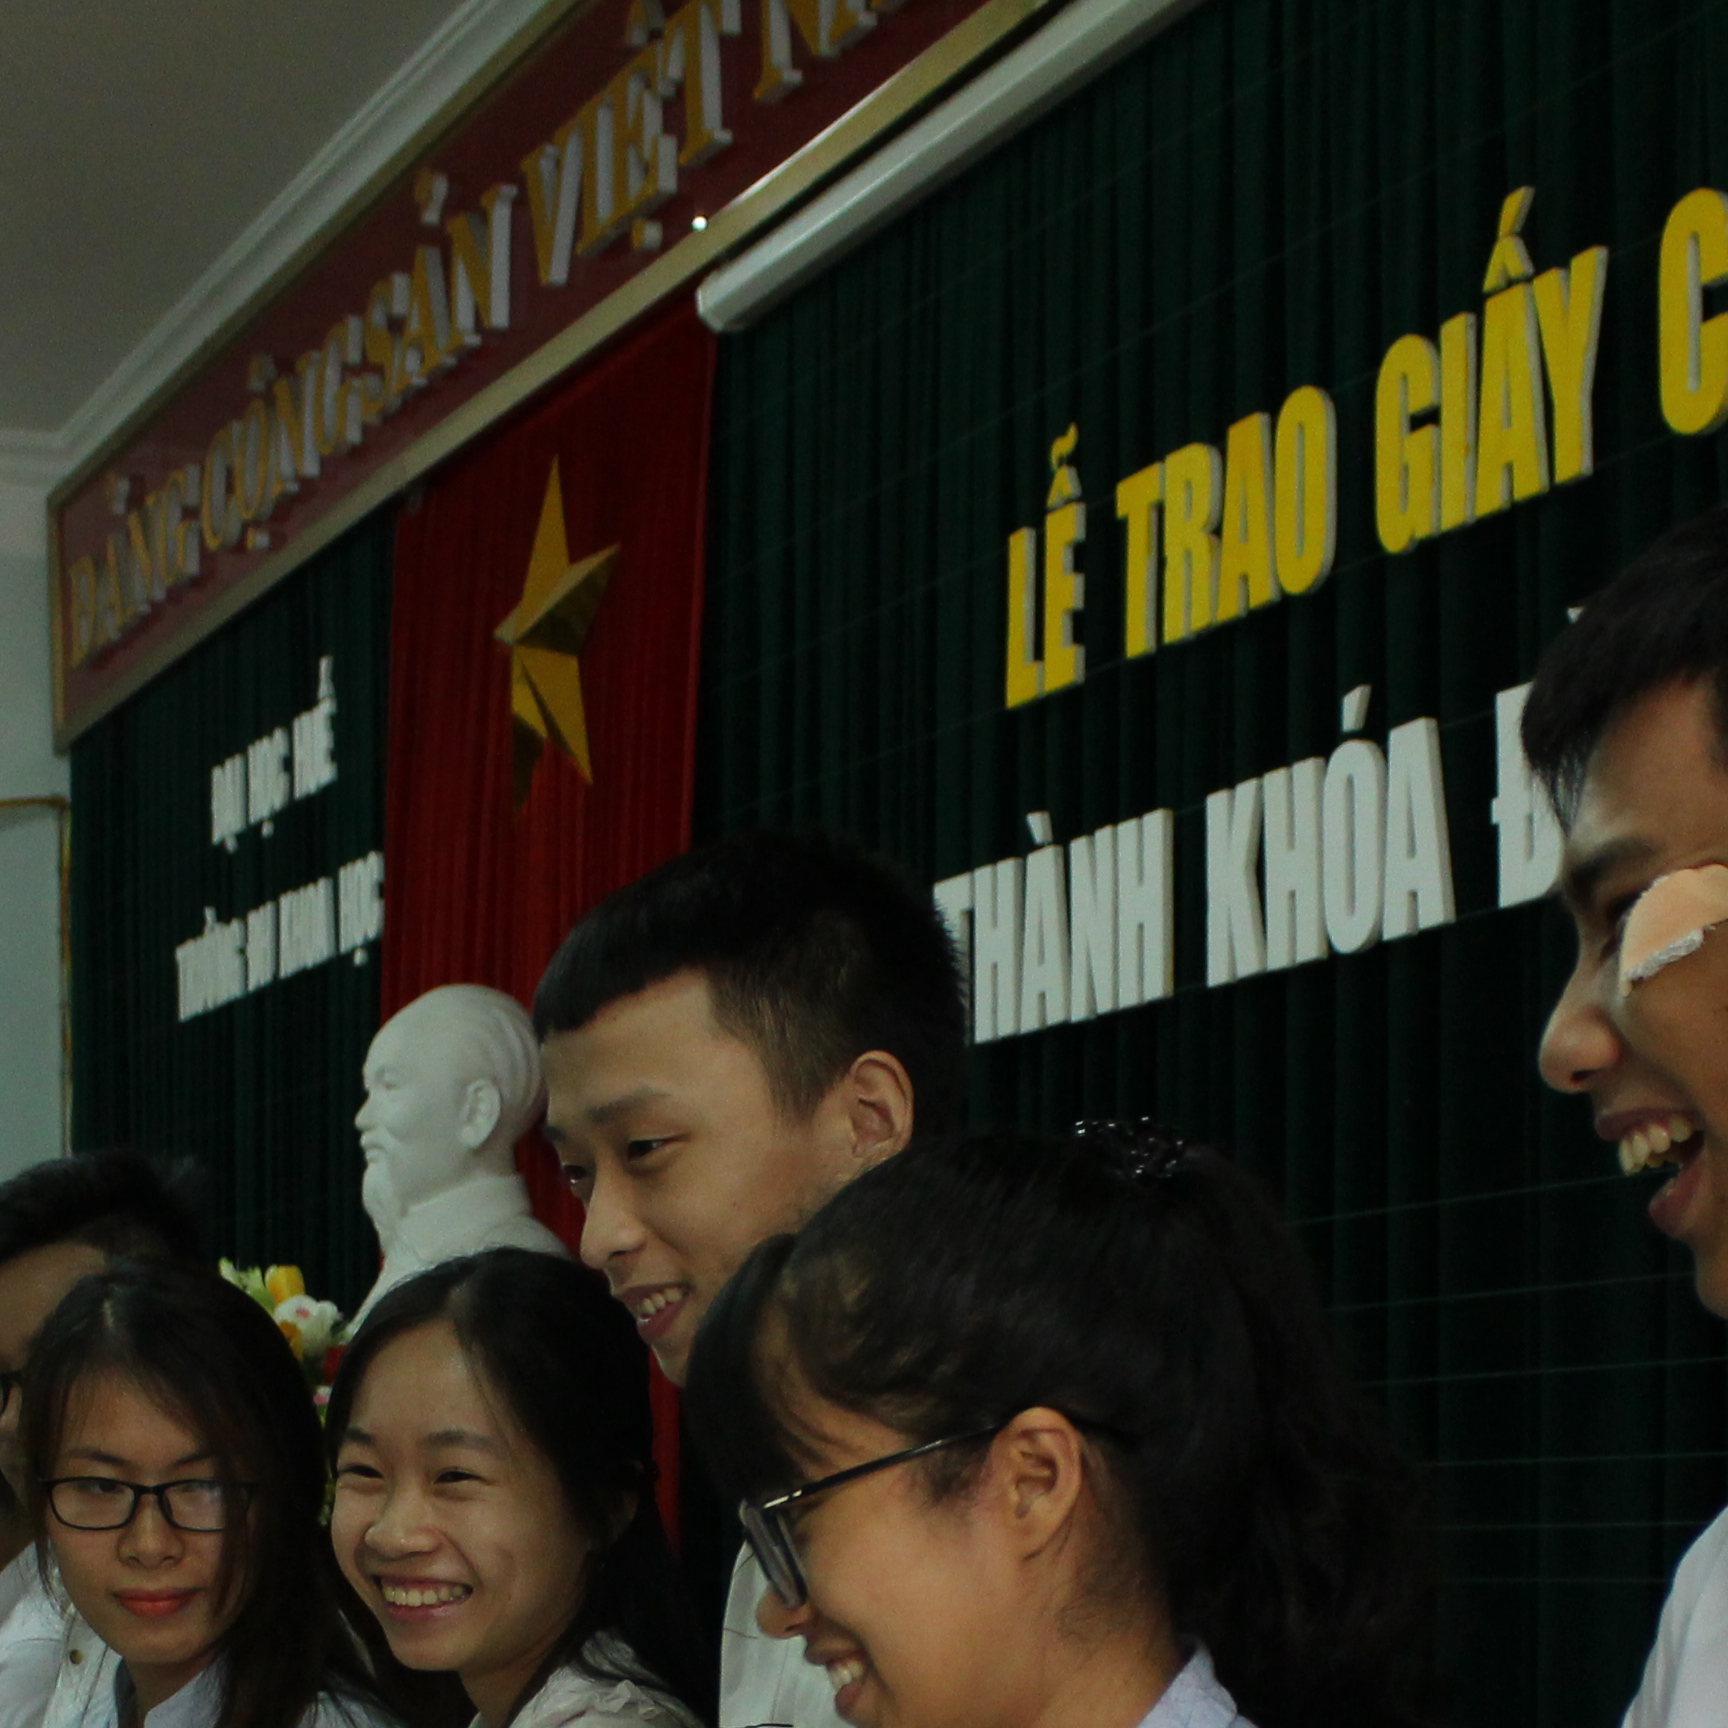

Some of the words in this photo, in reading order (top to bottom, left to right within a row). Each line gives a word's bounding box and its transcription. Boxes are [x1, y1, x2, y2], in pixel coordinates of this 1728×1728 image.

[367, 170, 519, 412] SẢN
[1005, 424, 1085, 709] LỄ
[1115, 385, 1336, 660] TRAO
[1374, 186, 1608, 555] GIẤY
[933, 810, 1174, 1046] THÀNH
[1206, 685, 1454, 989] KHÓA
